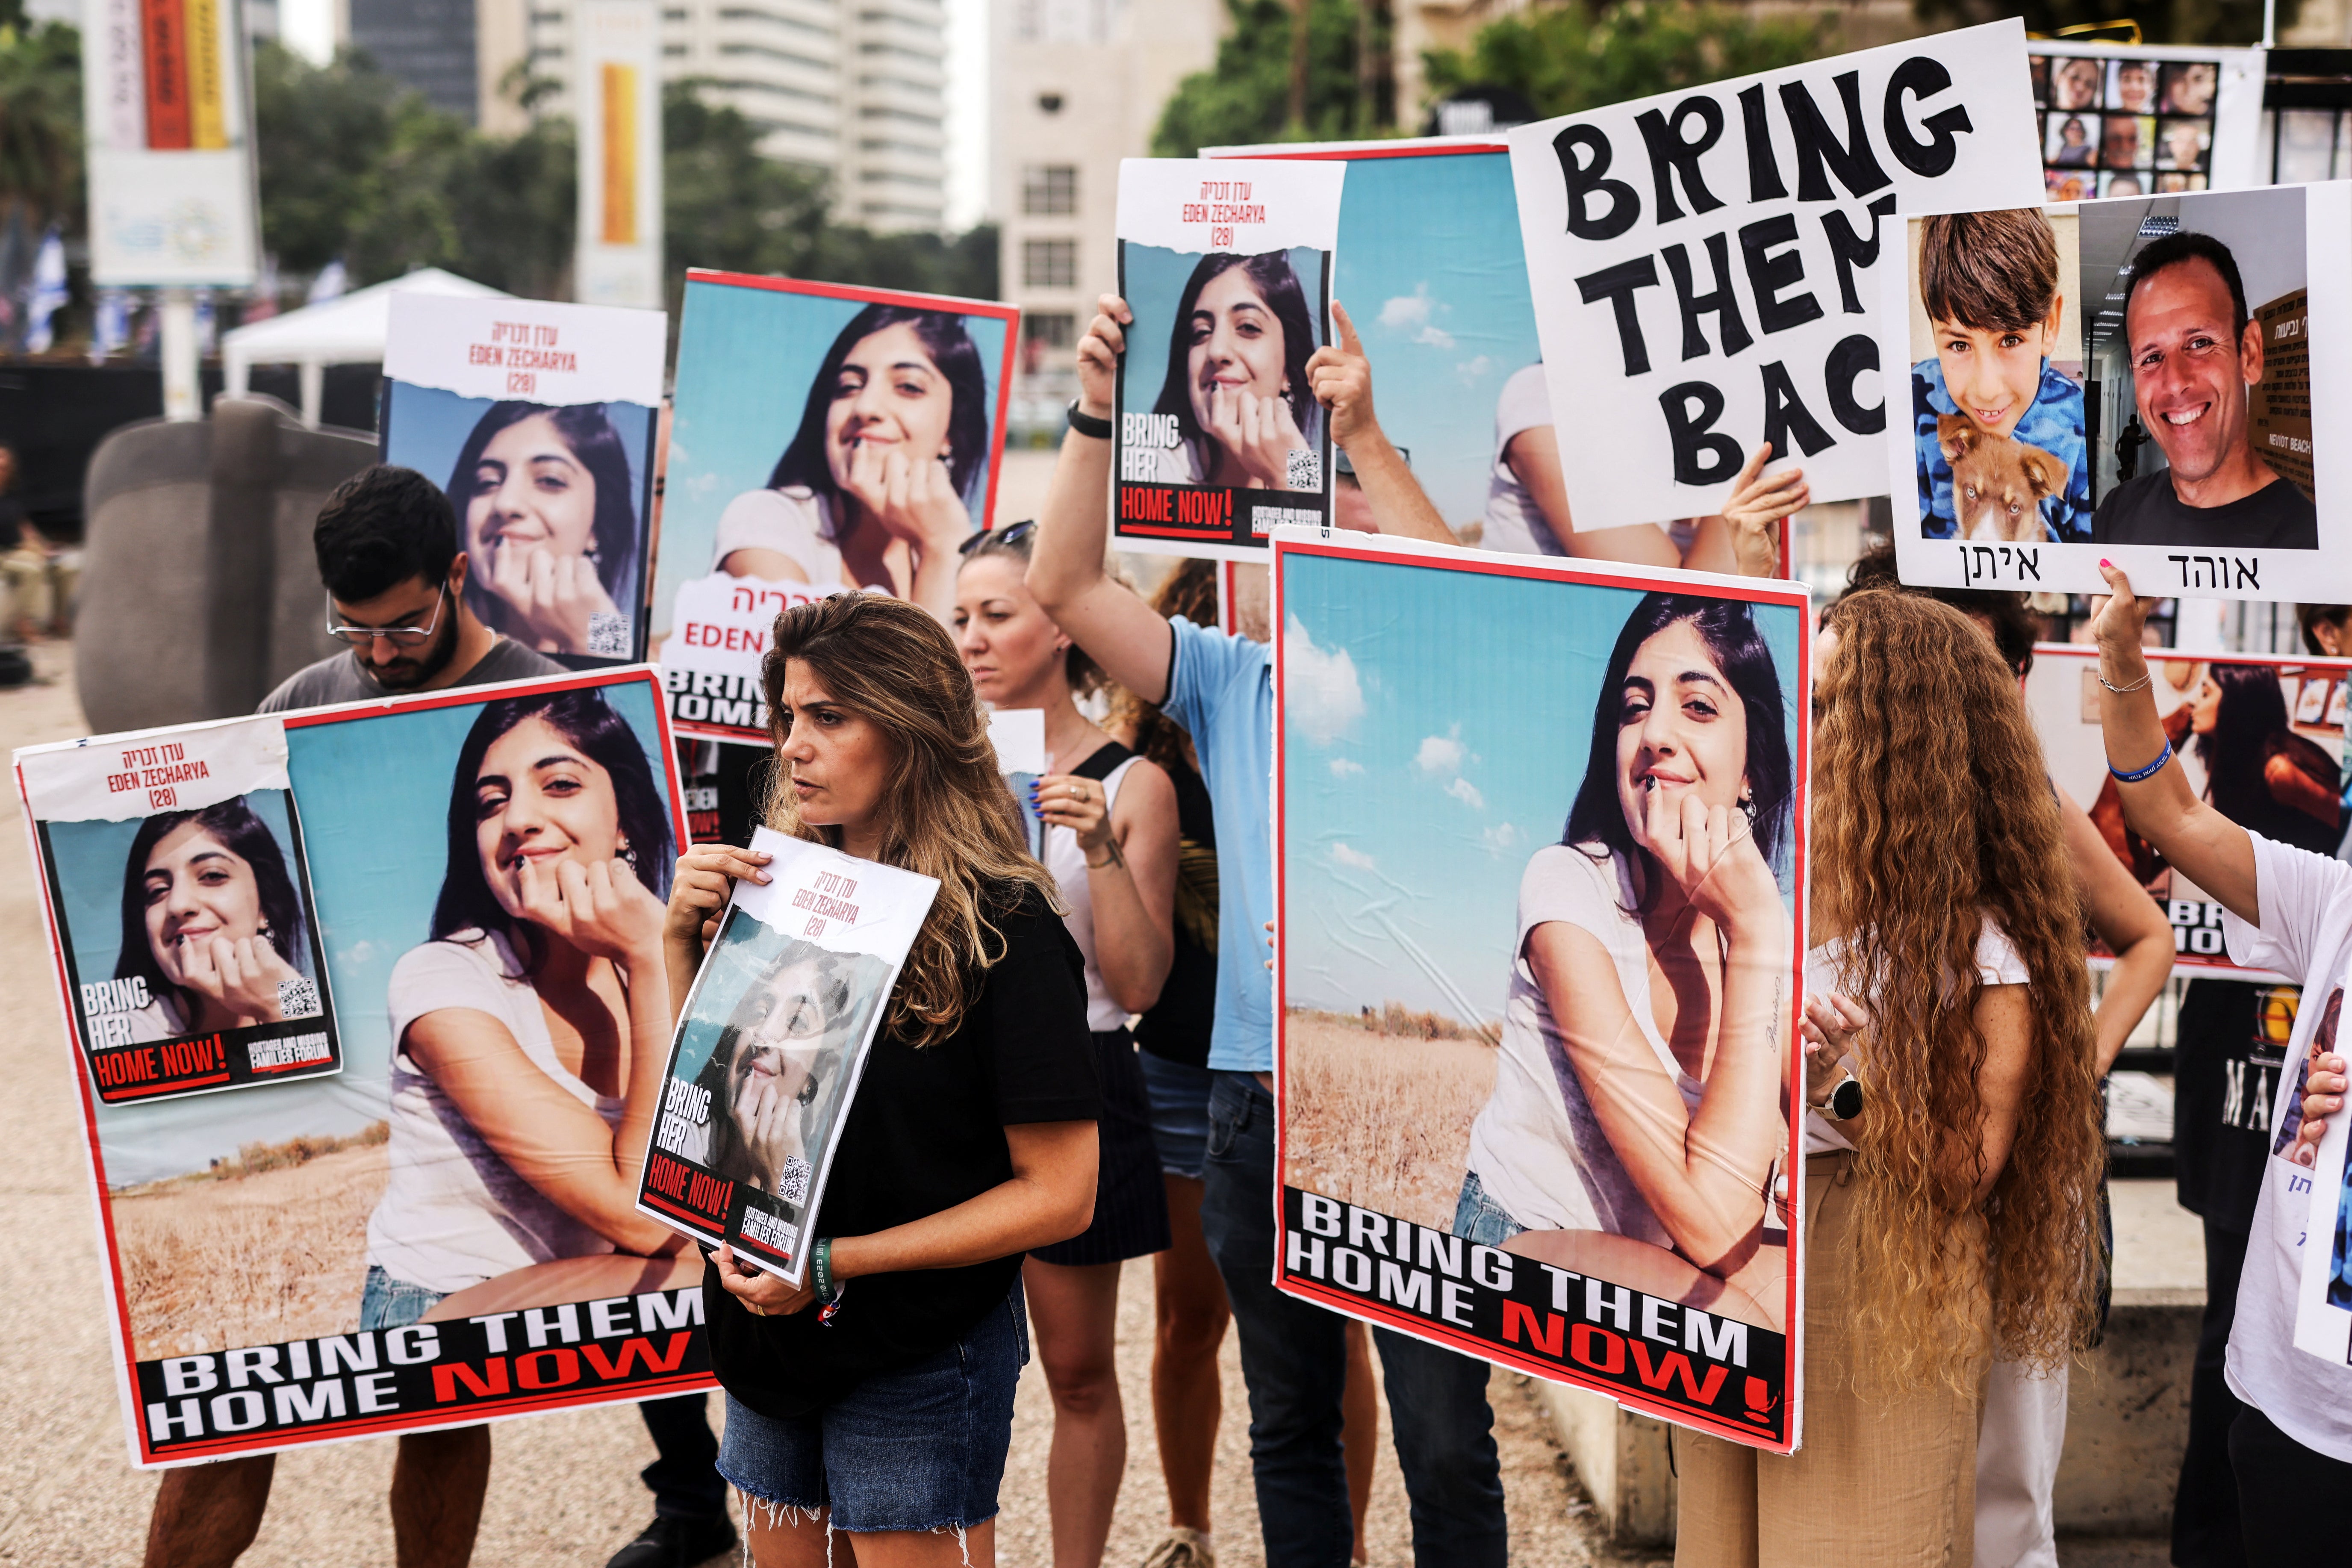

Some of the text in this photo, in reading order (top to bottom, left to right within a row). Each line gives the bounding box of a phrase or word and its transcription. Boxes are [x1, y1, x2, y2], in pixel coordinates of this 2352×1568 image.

[1553, 56, 1973, 240] BRING
[1200, 182, 1252, 202] עדן זכריה
[1183, 204, 1265, 223] EDEN ZECHARYA
[1211, 226, 1234, 248] (28)
[492, 321, 558, 347] עדן זכריה
[469, 343, 577, 373] EDEN ZECHARYA
[507, 372, 536, 396] (28)
[1659, 334, 1885, 486] BAC
[1122, 412, 1179, 448] BRING
[2269, 433, 2311, 454] NEVIOT BEACH
[1121, 448, 1157, 482] HER
[1121, 487, 1232, 527] HOME NOW!
[1959, 546, 2260, 590] אוהד איתן
[685, 622, 764, 653] EDEN
[665, 670, 766, 703] BRIN
[121, 743, 184, 769] עדן זכריה
[107, 761, 209, 793] EDEN ZECHARYA
[149, 787, 177, 810] (28)
[688, 811, 720, 834] OW!
[813, 871, 858, 898] עדן זכריה
[792, 888, 859, 925] EDEN ZECHARYA
[803, 915, 827, 940] (28)
[80, 976, 150, 1016] BRING
[86, 1014, 134, 1051] HER
[248, 1031, 328, 1055] HOSTAGES AND MISSING
[94, 1034, 227, 1087] HOME NOW!
[250, 1043, 331, 1069] FAMILIES FORUM
[665, 1076, 711, 1124] BRING
[656, 1113, 687, 1156] HER
[648, 1153, 734, 1220] HOME NOW!
[741, 1217, 796, 1255] FAMILIES FORUM
[745, 1205, 798, 1239] HOSTAGES AND MISSING
[1301, 1191, 1748, 1368] BRING THEM
[161, 1288, 704, 1397] BRING THEM
[1286, 1230, 1781, 1424] HOME NOW!
[147, 1371, 399, 1442] HOME
